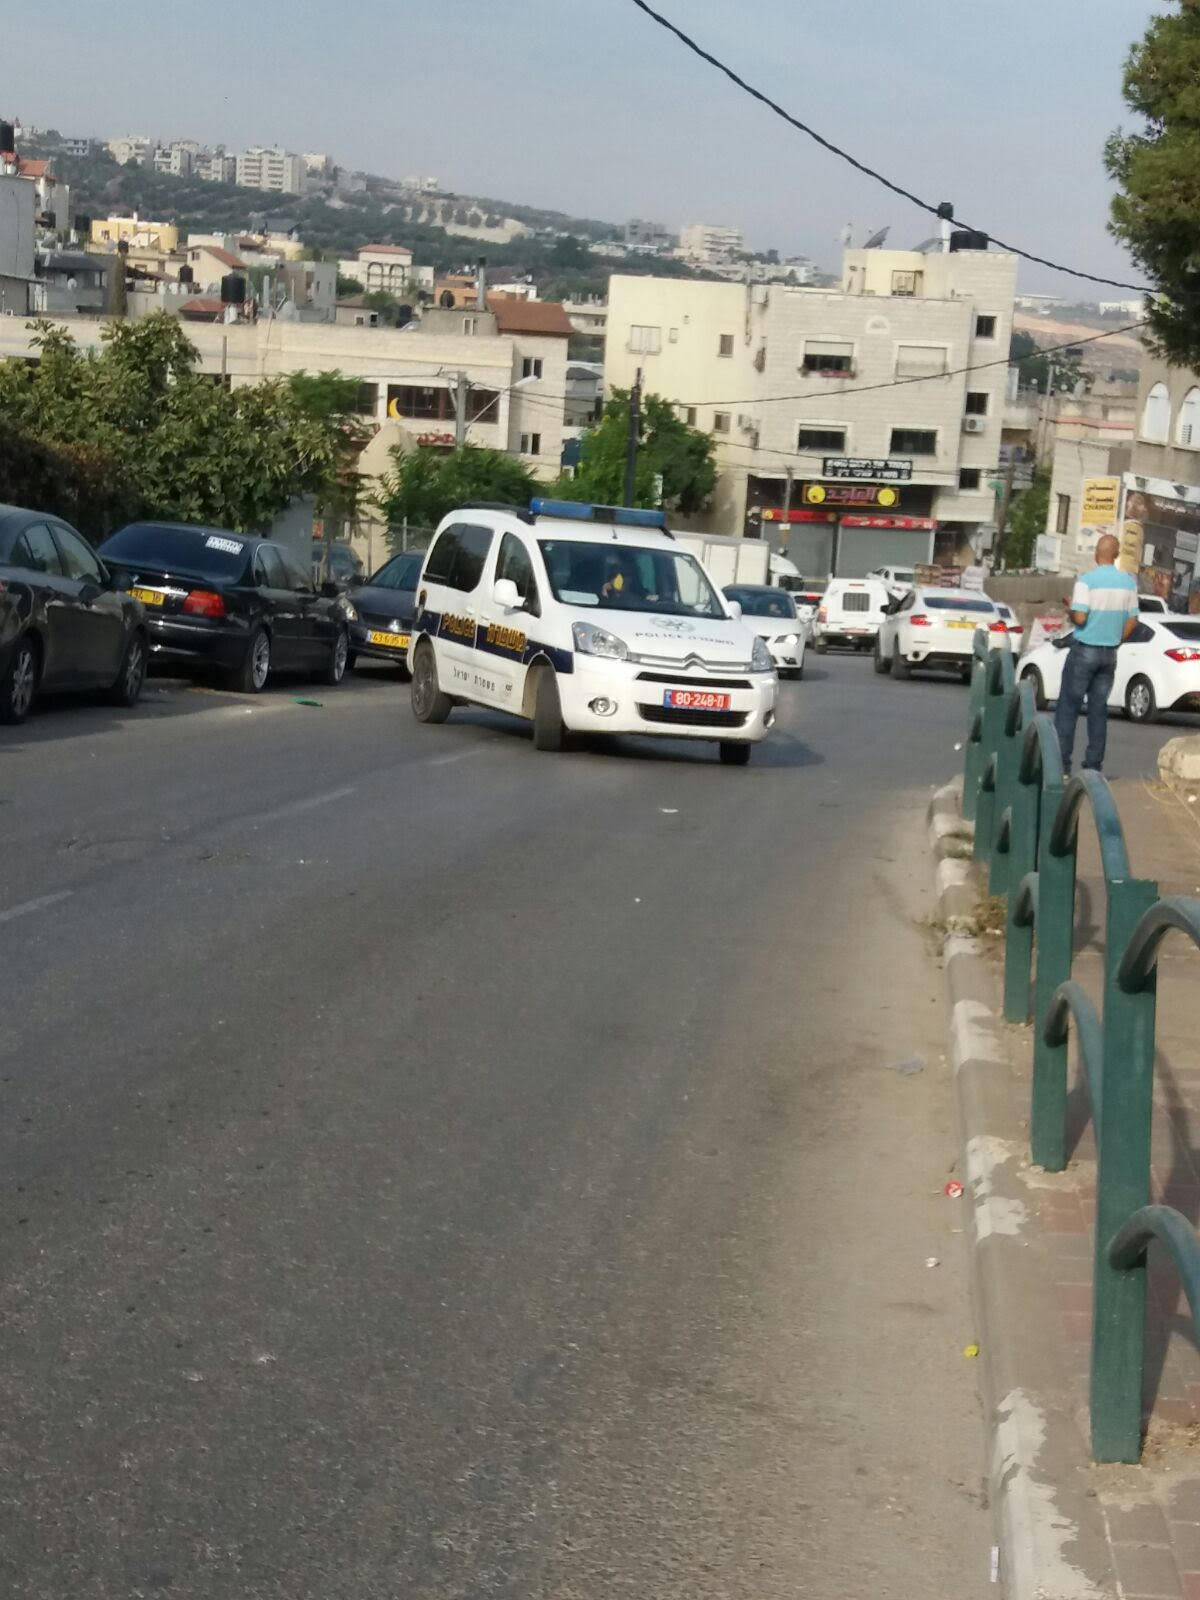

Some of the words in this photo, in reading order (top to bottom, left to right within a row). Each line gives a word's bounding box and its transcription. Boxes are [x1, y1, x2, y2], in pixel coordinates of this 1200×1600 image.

[1083, 503, 1114, 511] CHANGE
[441, 611, 476, 638] POLICE
[486, 622, 526, 652] משטרה
